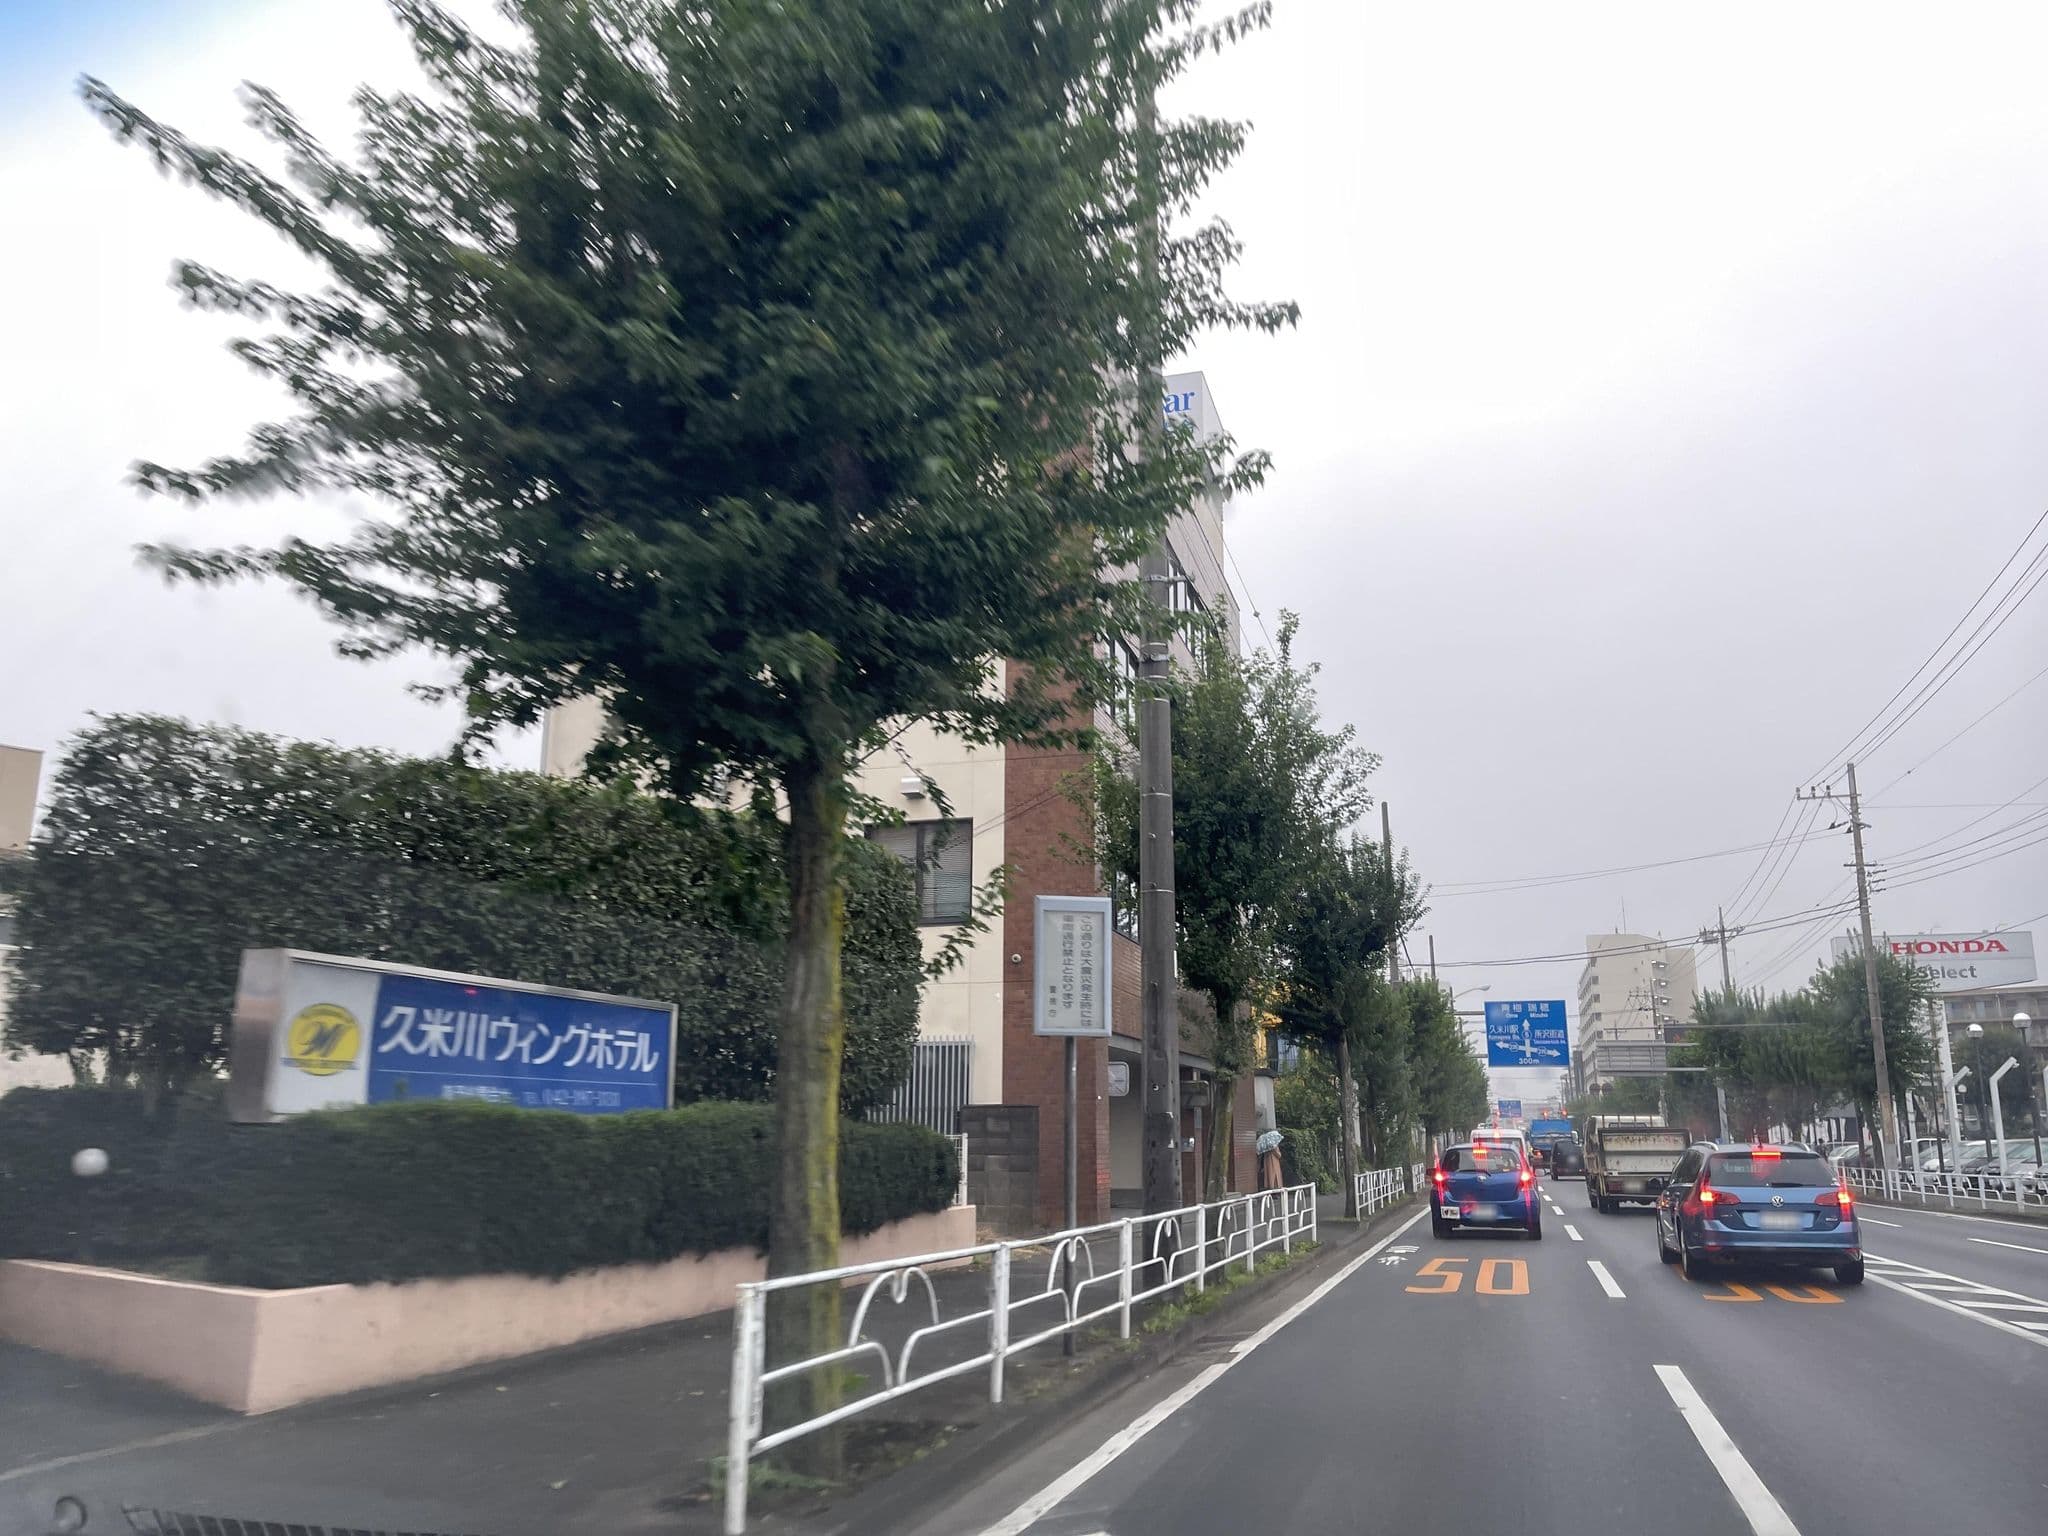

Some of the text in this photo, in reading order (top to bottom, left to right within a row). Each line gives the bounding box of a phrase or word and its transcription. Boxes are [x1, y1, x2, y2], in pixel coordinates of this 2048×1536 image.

[1891, 939, 2009, 955] HONDA
[1489, 1024, 1520, 1034] 久米川駅
[1534, 1028, 1565, 1039] 所沢街道
[378, 1004, 659, 1074] 久米川ウィングホテル
[1404, 1257, 1531, 1296] 50
